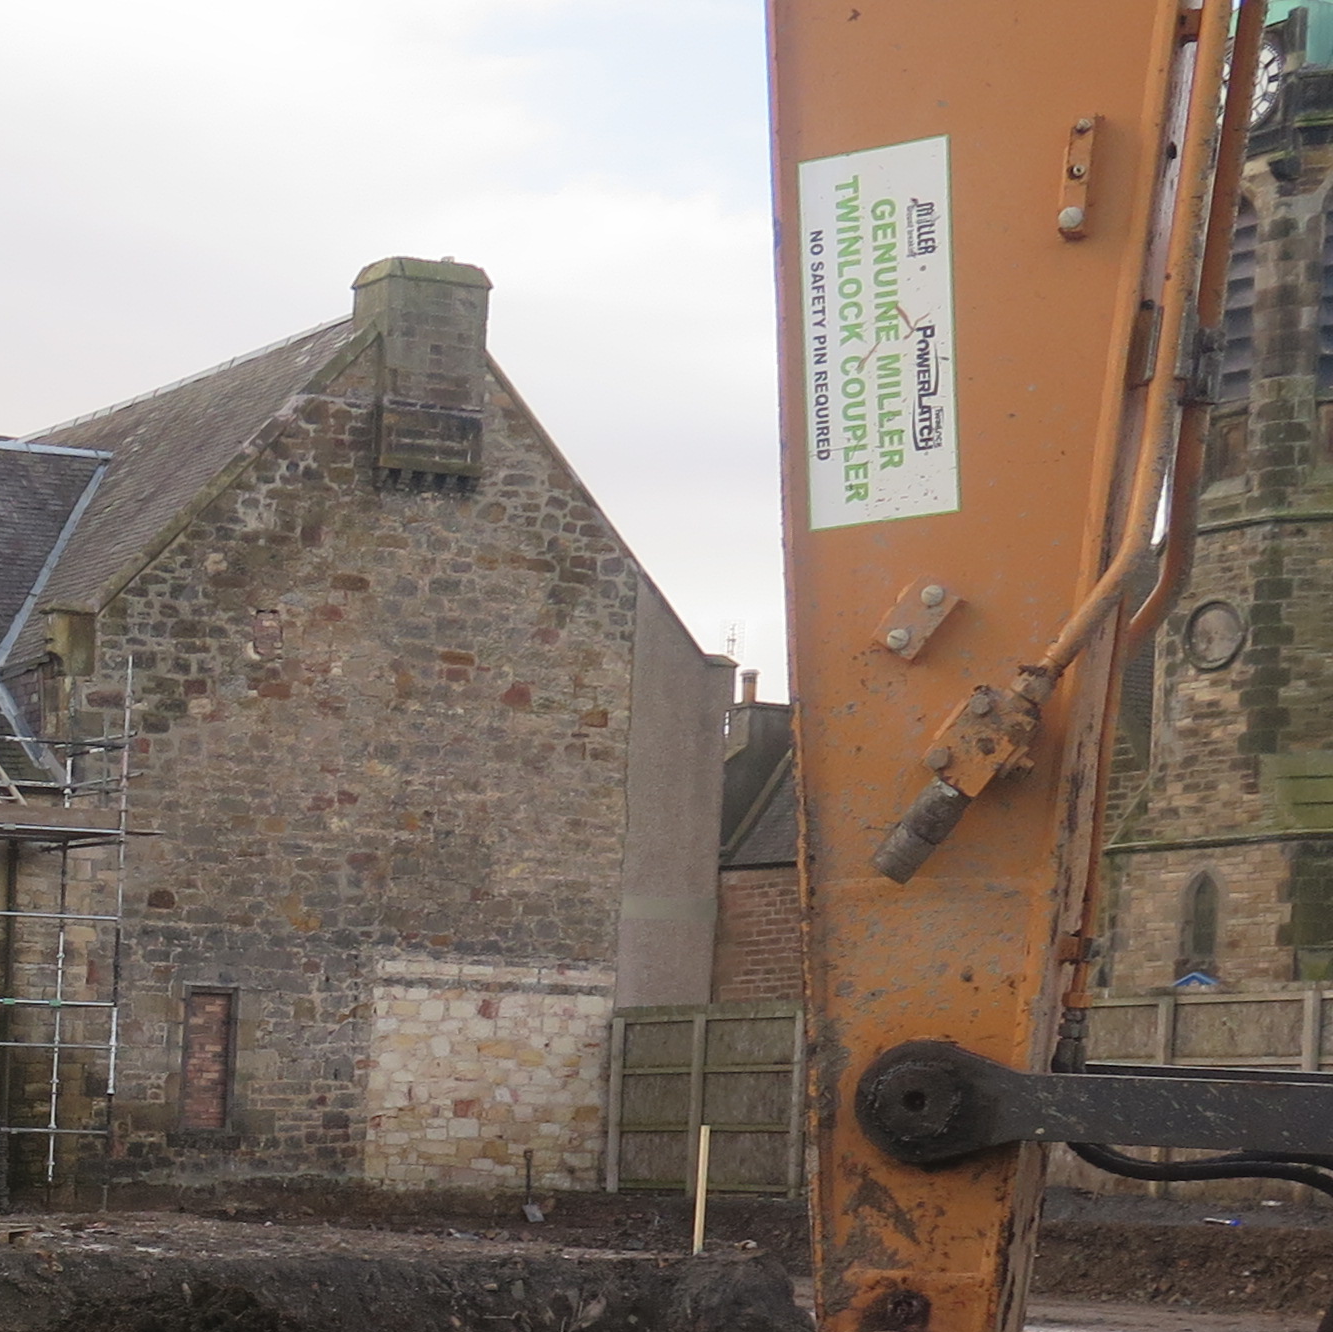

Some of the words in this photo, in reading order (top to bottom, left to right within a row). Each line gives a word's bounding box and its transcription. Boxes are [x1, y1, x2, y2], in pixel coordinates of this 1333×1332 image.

[810, 230, 824, 256] NO
[835, 174, 866, 346] TWINLOCK
[871, 198, 899, 341] GENUINE
[915, 201, 937, 256] MILLER
[811, 261, 827, 329] SAFETY
[813, 335, 827, 365] PIN
[814, 370, 831, 461] REQUIRED
[840, 356, 869, 504] COUPLER
[876, 353, 904, 470] MILLER
